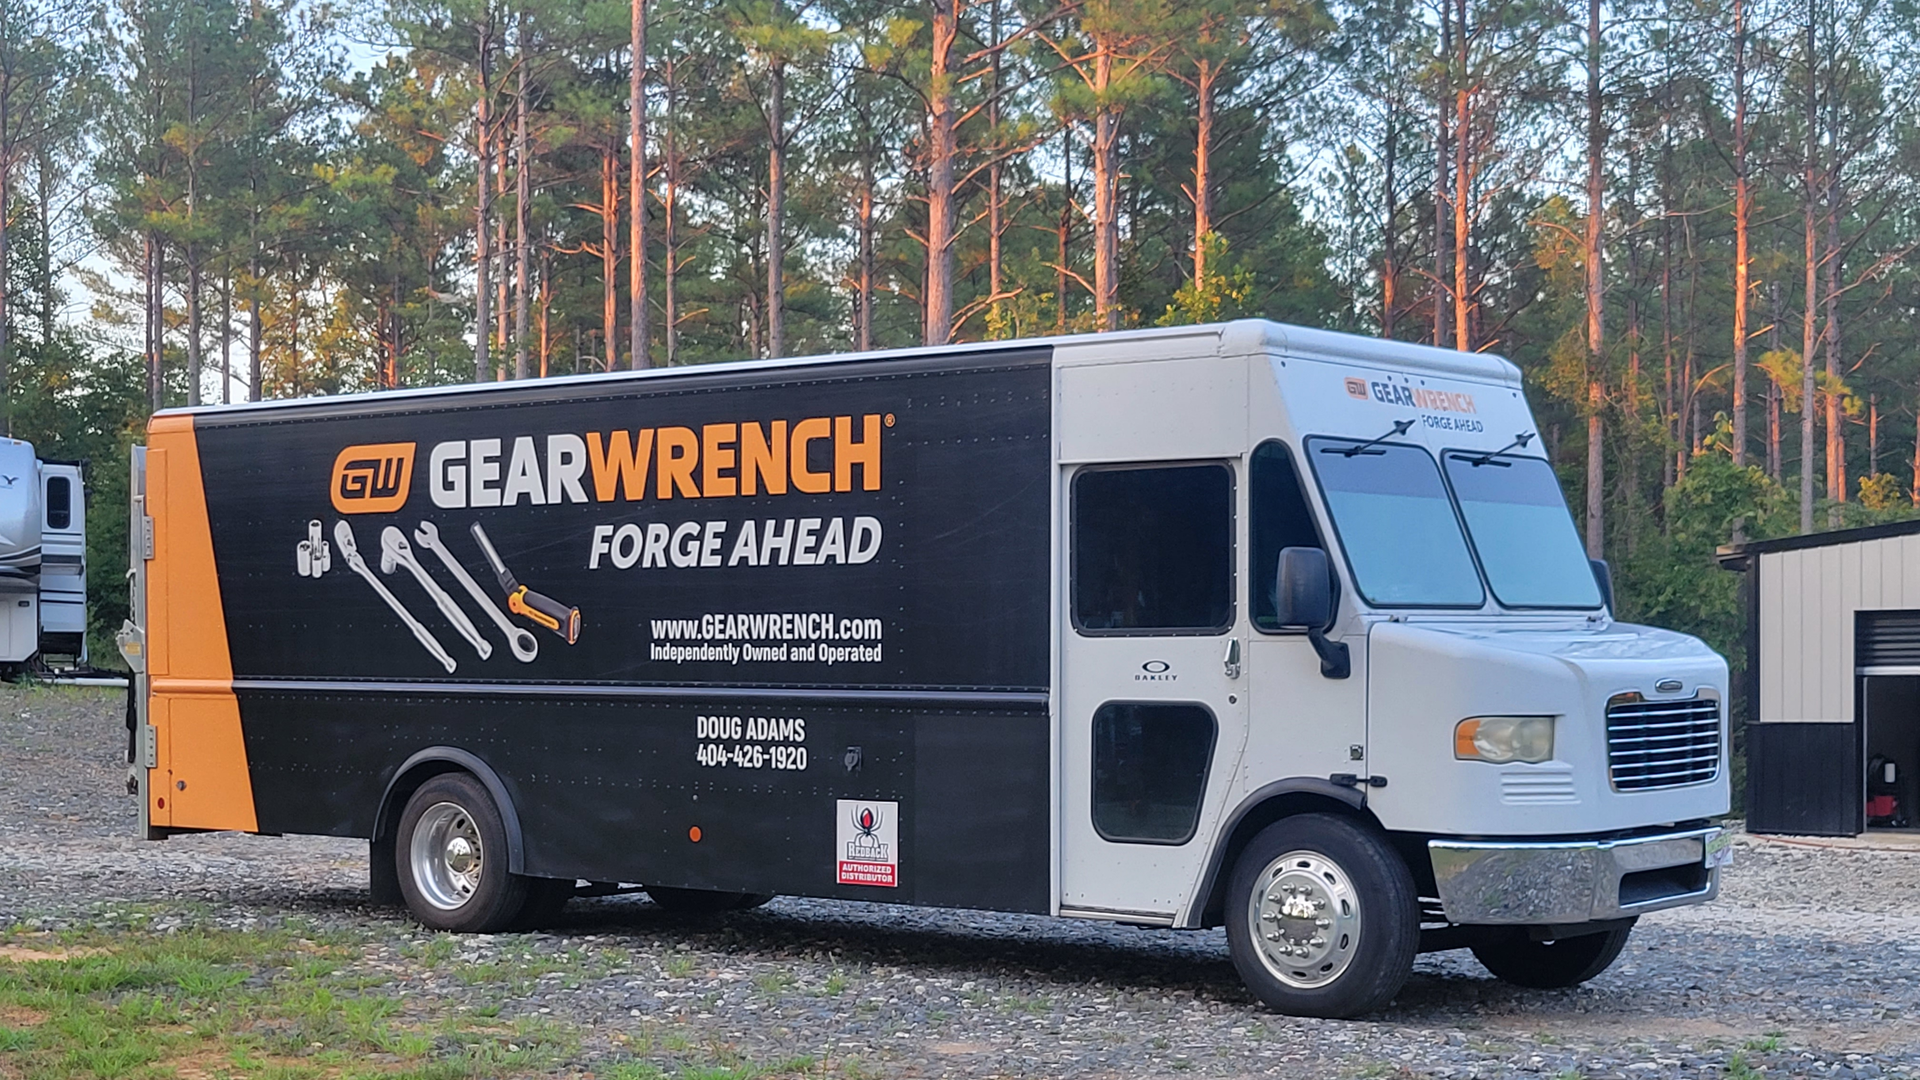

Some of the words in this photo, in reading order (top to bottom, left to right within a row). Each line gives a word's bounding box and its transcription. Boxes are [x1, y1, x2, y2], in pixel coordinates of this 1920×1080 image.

[1371, 381, 1477, 414] GEARWRENCH
[1421, 414, 1452, 430] FORGE
[1453, 418, 1484, 433] AHEAD
[429, 414, 881, 509] GEARWRENCH
[588, 519, 728, 570] FORGE
[727, 515, 883, 567] AHEAD
[650, 613, 883, 641] www.GEARWRENCH.com
[650, 643, 740, 665] Independently
[742, 643, 788, 662] Owned
[790, 643, 816, 662] and
[818, 643, 883, 666] Operated
[696, 716, 742, 740] DOUG
[745, 718, 806, 743] ADAMS
[696, 744, 807, 770] 404-426-1920
[847, 841, 888, 860] REDBACK
[840, 871, 894, 883] DISTRIBUTOR
[841, 862, 893, 874] AUTHORIZED
